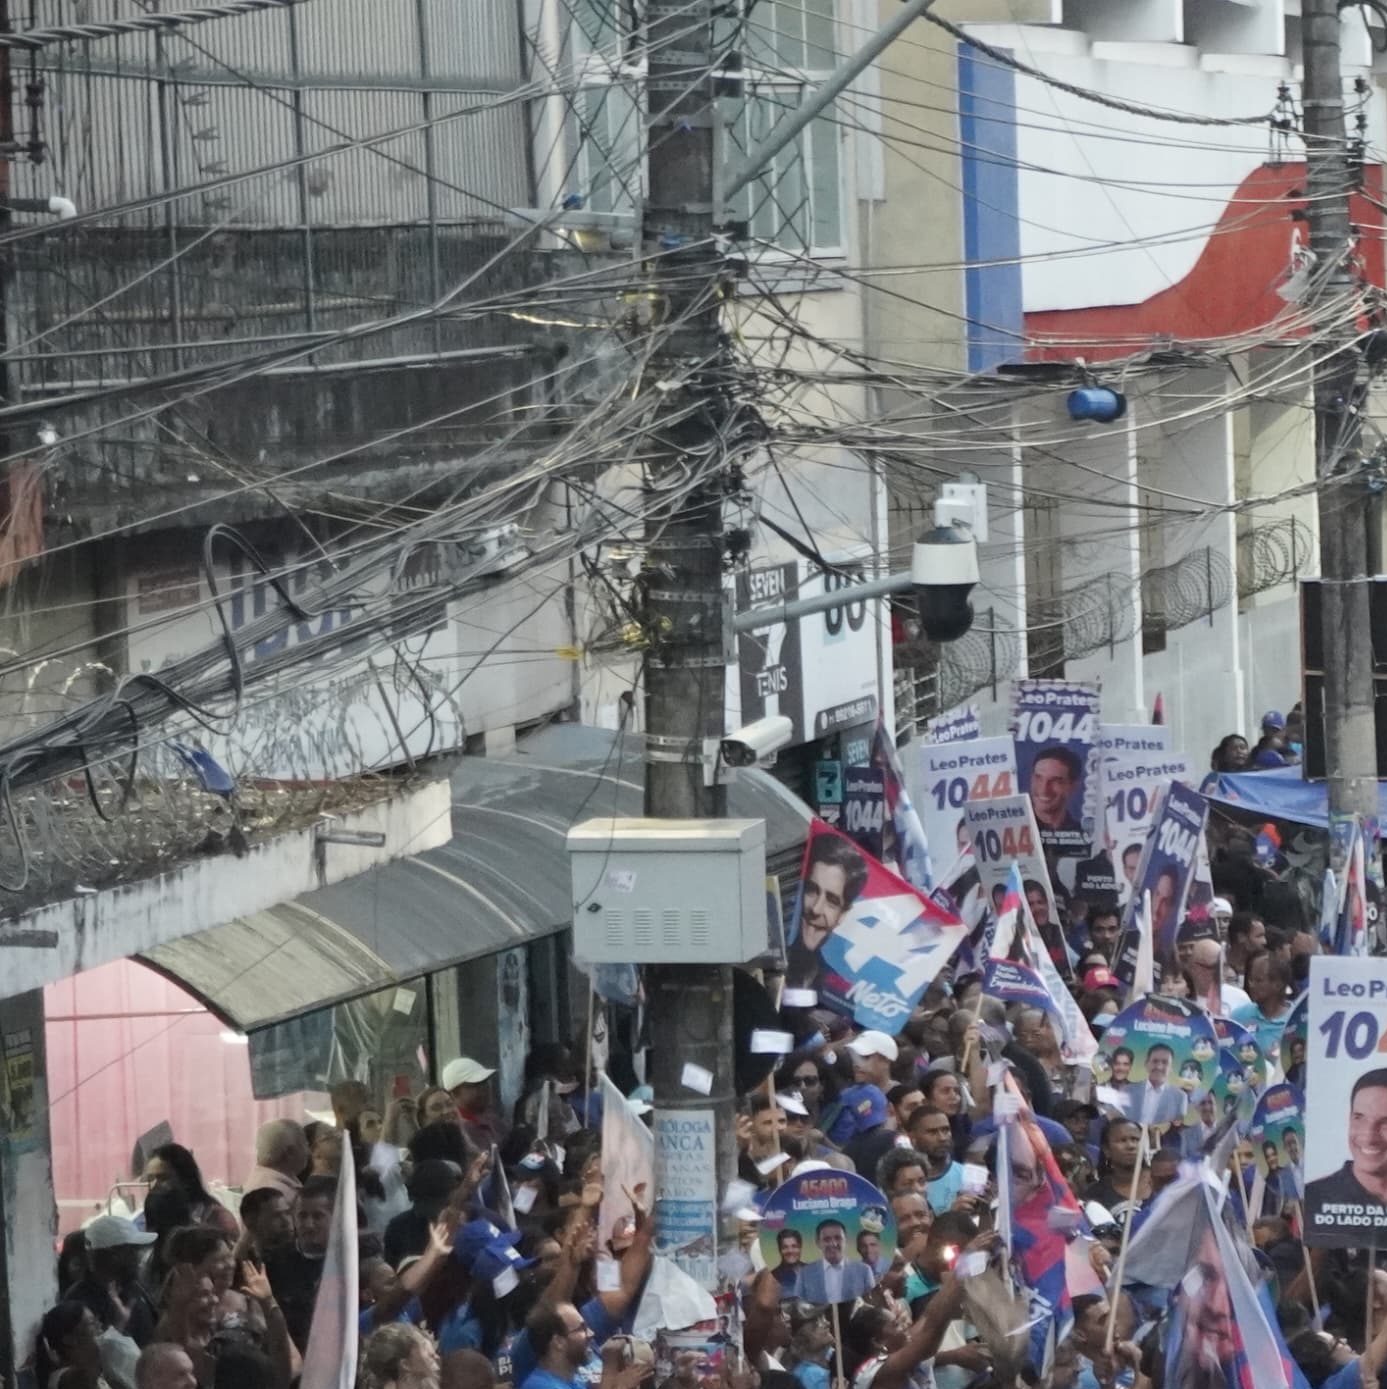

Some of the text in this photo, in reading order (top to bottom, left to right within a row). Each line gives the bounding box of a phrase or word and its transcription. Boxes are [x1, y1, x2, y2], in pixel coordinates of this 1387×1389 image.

[1016, 711, 1096, 744] 1044
[931, 770, 1012, 811] 1044
[975, 825, 1035, 864] 1044
[845, 979, 913, 1019] Neto
[1315, 1214, 1335, 1226] DO
[1337, 1215, 1372, 1227] LADO
[1322, 1203, 1363, 1216] PERTO
[1366, 1204, 1385, 1216] DA
